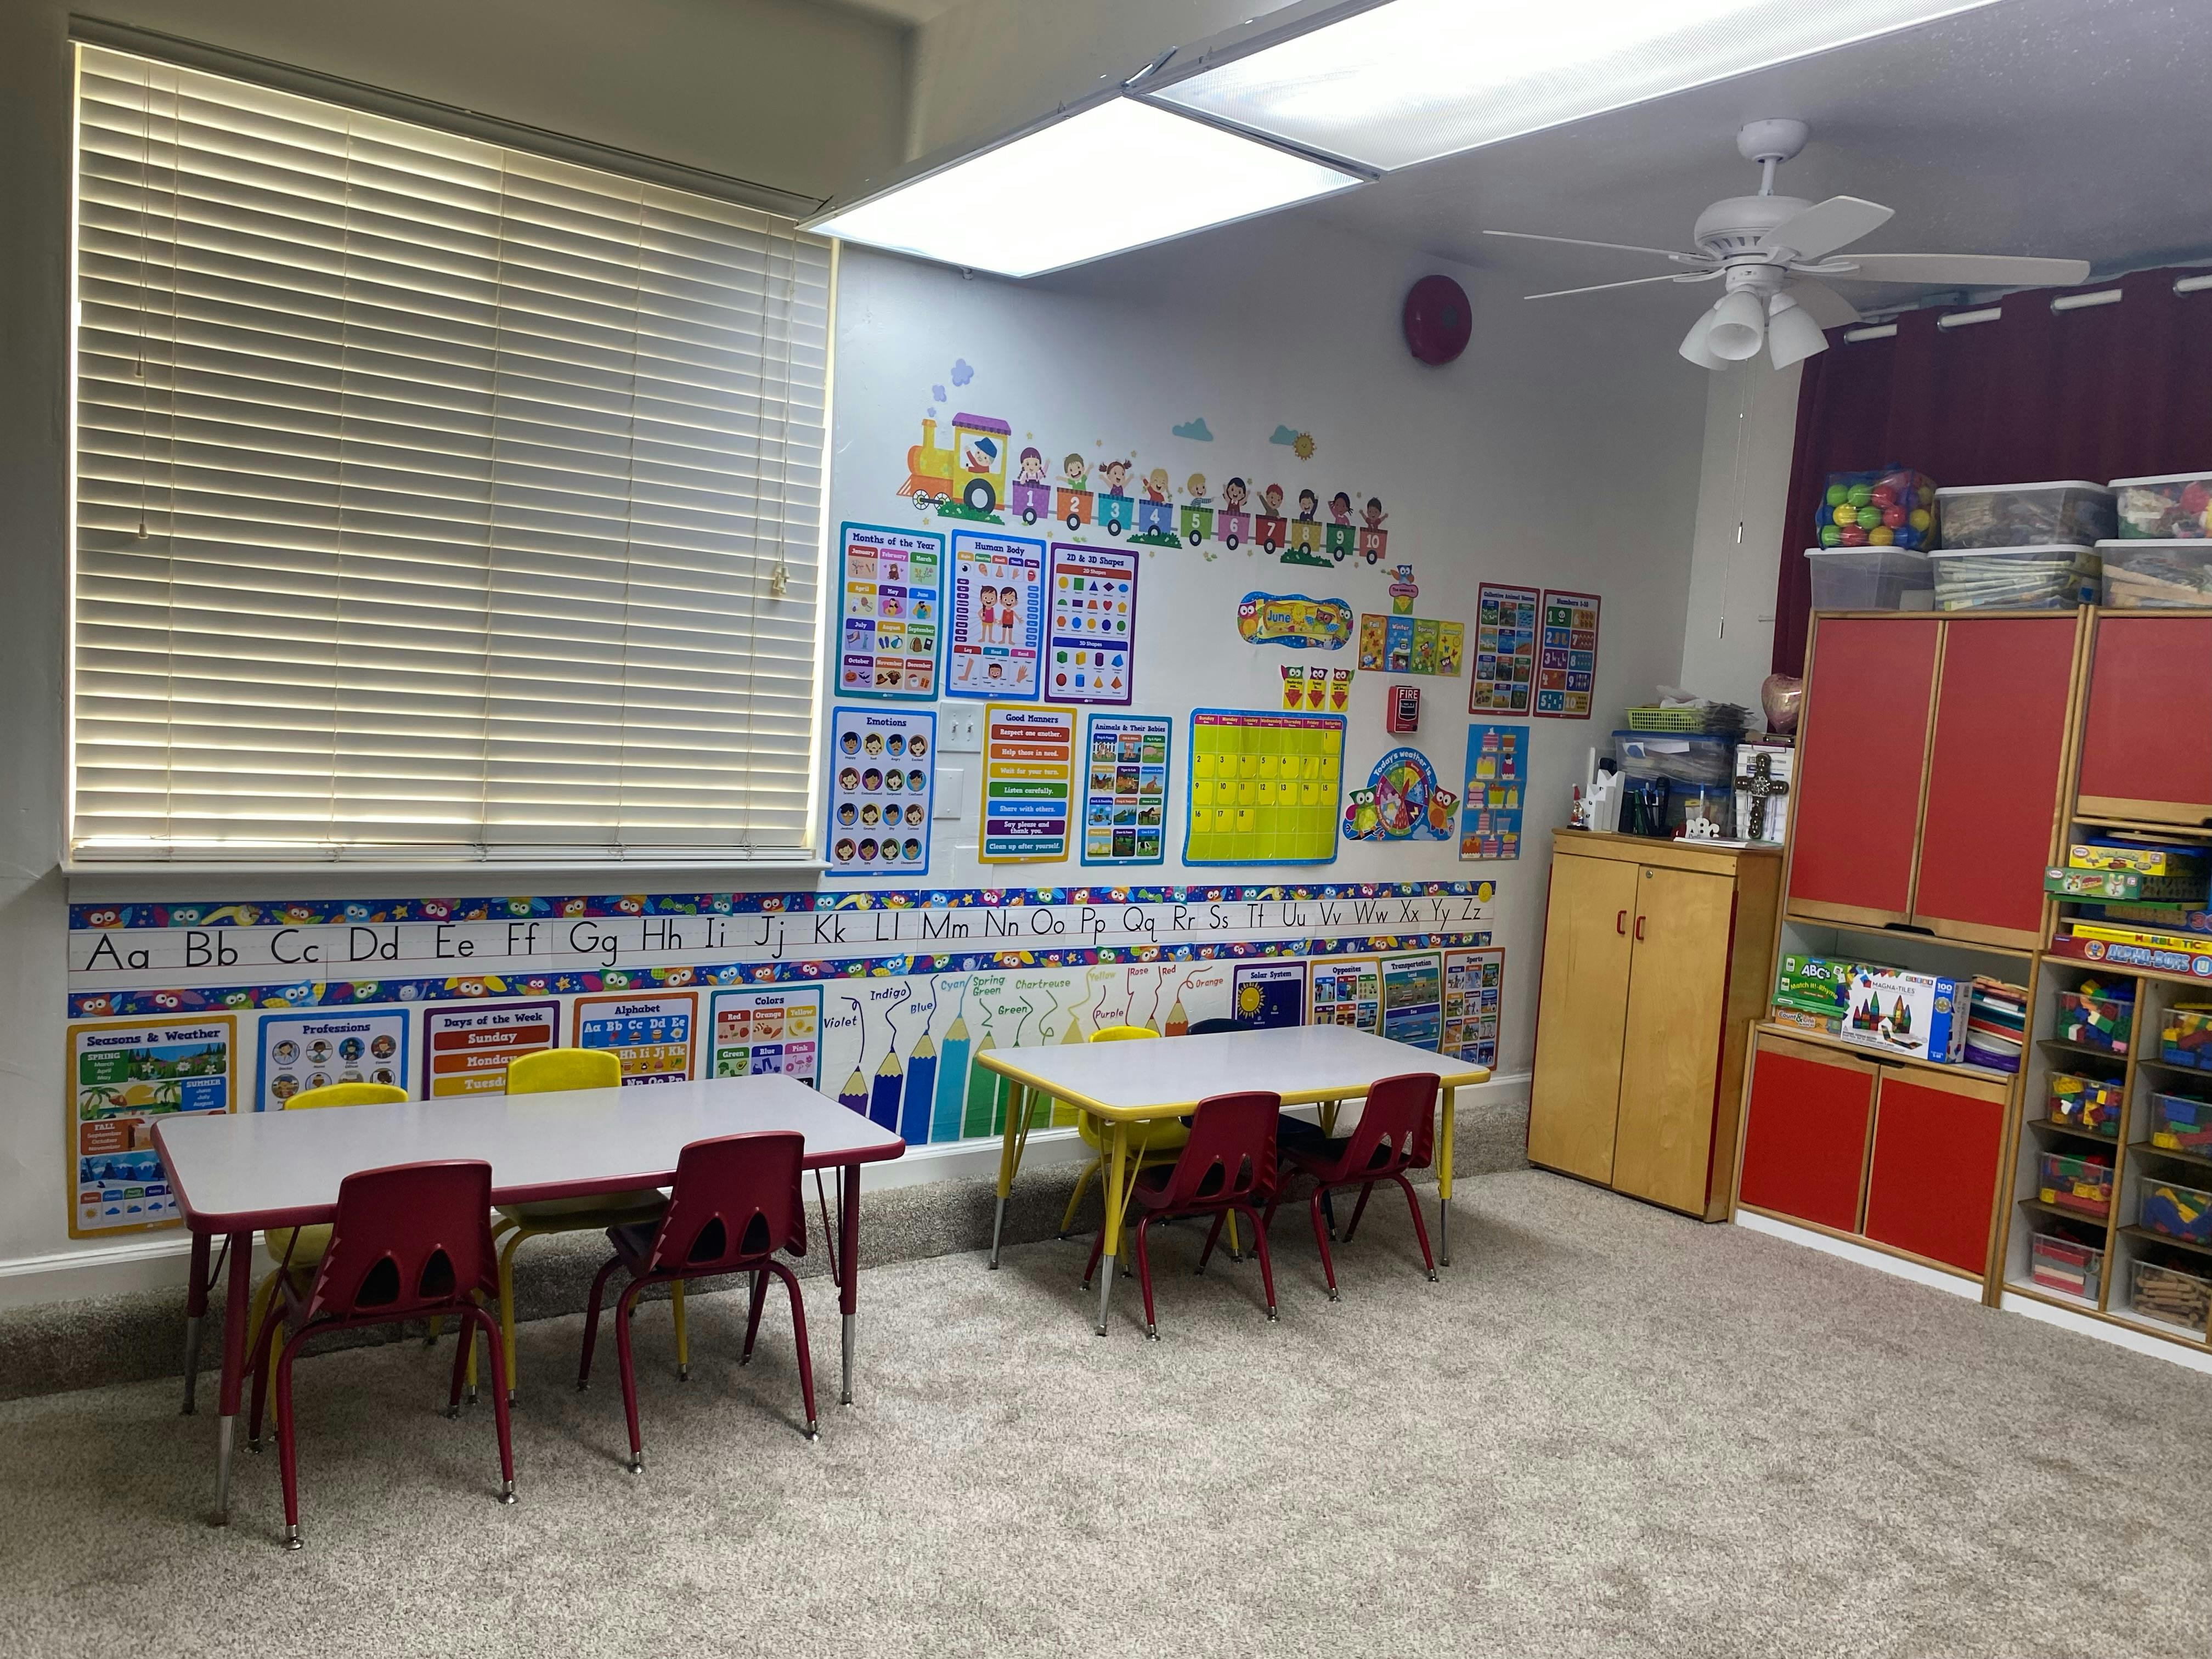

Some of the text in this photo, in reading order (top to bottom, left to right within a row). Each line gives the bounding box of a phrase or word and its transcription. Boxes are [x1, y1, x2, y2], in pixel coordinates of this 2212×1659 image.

[1026, 490, 1034, 507] 1
[1070, 496, 1080, 513] 2
[1111, 502, 1120, 518] 3
[1150, 509, 1160, 524] 4
[1192, 514, 1200, 528] 5
[1230, 518, 1238, 532] 6
[1267, 522, 1276, 537] 7
[1302, 527, 1309, 540] 8
[1336, 531, 1344, 544] 9
[853, 533, 884, 544] Months
[917, 541, 935, 550] Year
[1367, 534, 1379, 548] 10
[975, 542, 1024, 556] Human Body
[882, 552, 906, 560] February
[1100, 557, 1124, 567] Shapes
[1267, 610, 1290, 623] June
[1418, 627, 1435, 635] Spring
[1400, 690, 1418, 699] FIRE
[867, 718, 906, 726] Emotions
[1028, 715, 1058, 723] Manners
[1374, 751, 1426, 776] Today's weather
[86, 898, 1481, 970] Aa Bb Cc Dd Ee Ff Gg Hh Ii Jj Kk Ll Mm Nn Oo Pp Qq Rr Ss Tt Uu Vv Ww Xx Yy Zz
[2106, 944, 2190, 972] ALPHA-BOTS
[1163, 965, 1176, 975] Red
[1333, 966, 1361, 974] Opposites
[1391, 960, 1431, 969] Transportation
[1090, 971, 1116, 981] Yellow
[1802, 964, 1830, 979] ABC's
[941, 980, 965, 990] Cyan
[973, 976, 1005, 988] Spring
[1016, 980, 1070, 989] Chartreuse
[1196, 978, 1223, 988] Orange
[1872, 982, 1915, 994] MAGNA-TILES
[871, 989, 906, 1000] Indigo
[973, 988, 1001, 996] Green
[755, 997, 784, 1005] Colors
[615, 1005, 660, 1015] Alphabet
[911, 1002, 932, 1014] Blue
[998, 1006, 1027, 1014] Green
[1095, 1009, 1124, 1019] Purple
[444, 1013, 542, 1028] Days of the Week
[824, 1016, 857, 1028] Violet
[1779, 1011, 1796, 1019] Count
[1796, 1013, 1803, 1022] &
[303, 1023, 370, 1034] Professions
[87, 1029, 221, 1046] Seasons & Weather
[468, 1032, 517, 1044] Sunday
